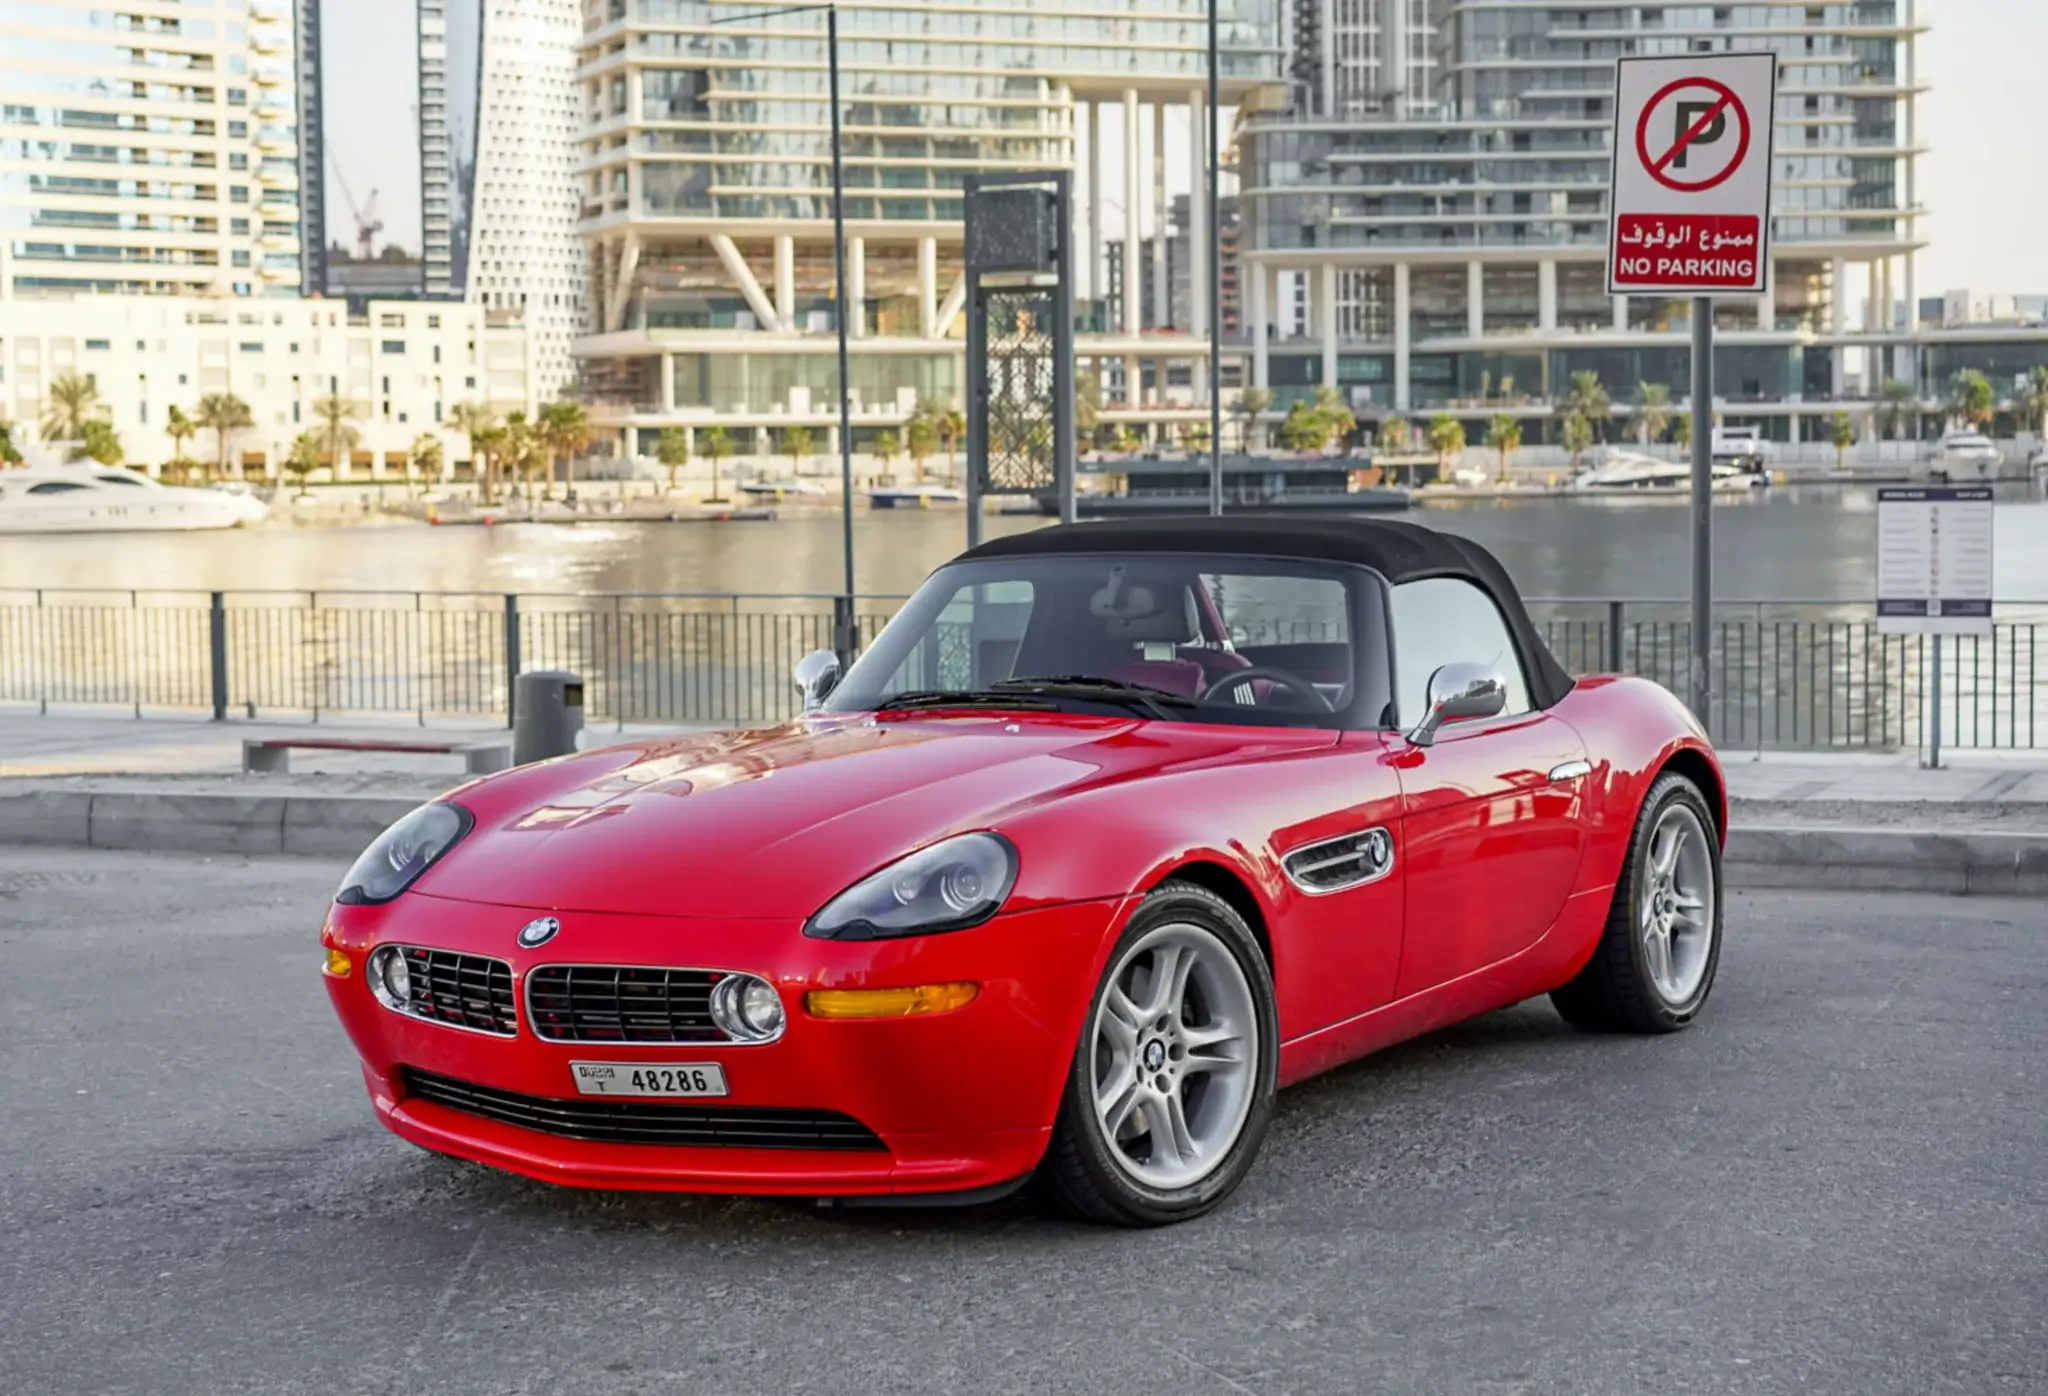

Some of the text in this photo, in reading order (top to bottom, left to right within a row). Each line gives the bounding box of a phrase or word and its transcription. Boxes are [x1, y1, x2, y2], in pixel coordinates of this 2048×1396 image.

[1672, 101, 1726, 169] P
[1621, 222, 1754, 251] ممنوع الوقوف
[1620, 257, 1753, 277] NO PARKING
[579, 1066, 615, 1078] DUI
[632, 1070, 707, 1092] 48286
[596, 1081, 606, 1092] T
